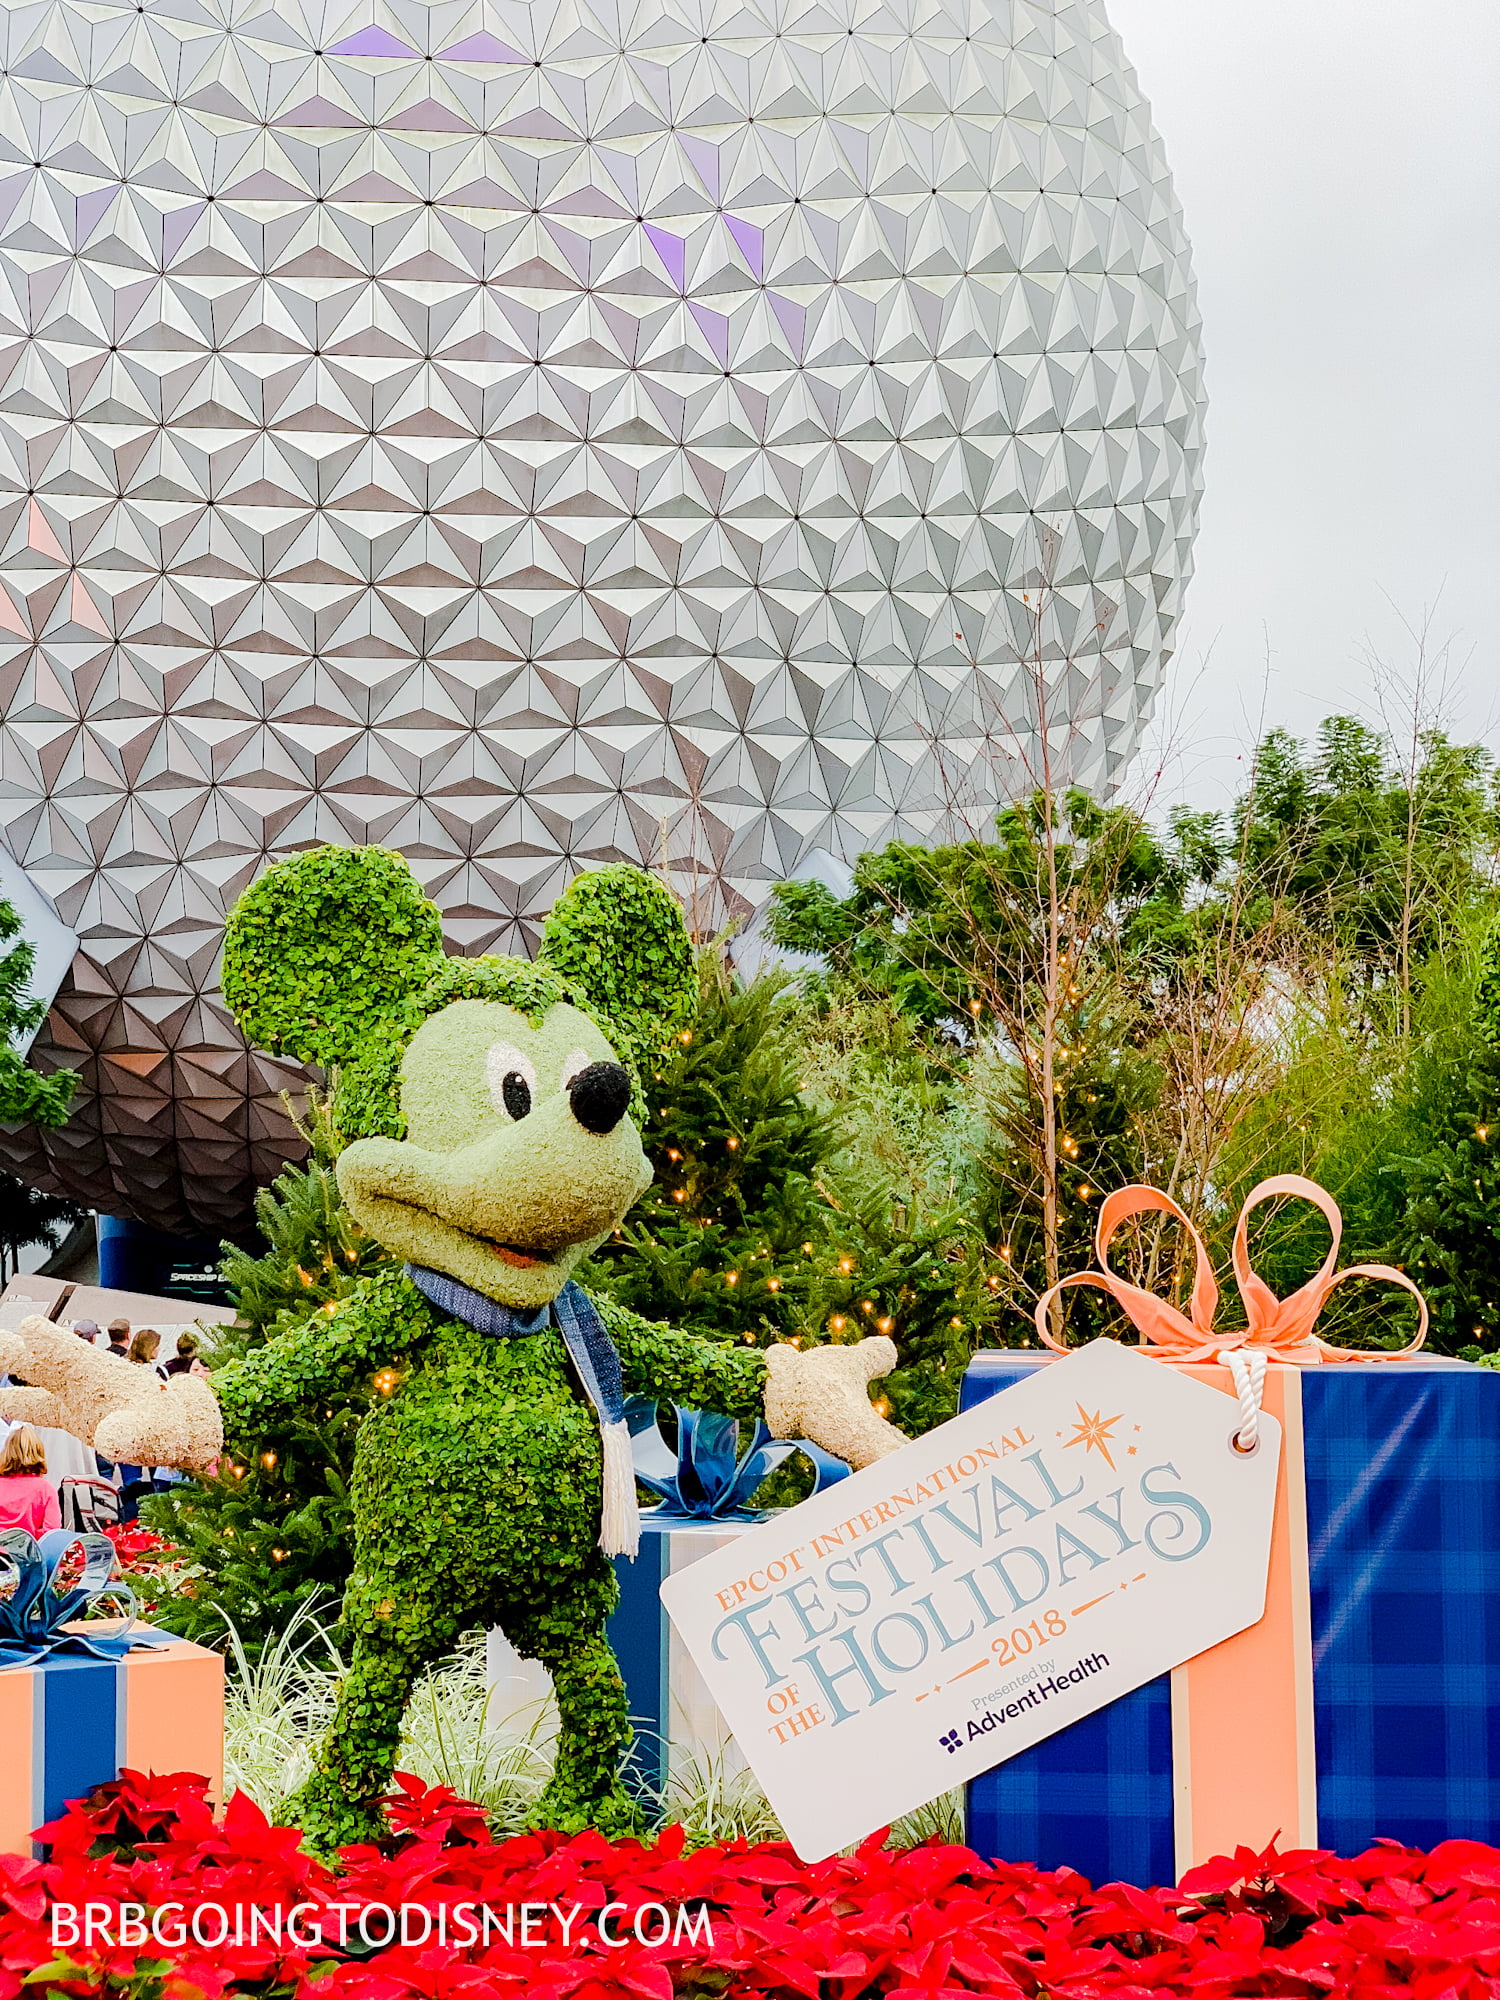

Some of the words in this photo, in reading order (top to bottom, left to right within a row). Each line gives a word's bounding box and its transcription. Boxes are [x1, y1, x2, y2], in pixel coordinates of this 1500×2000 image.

[809, 1426, 1035, 1559] INTERNATIONAL
[711, 1449, 1084, 1689] FESTIVAL
[792, 1462, 1212, 1727] HOLIDAYS
[991, 1609, 1067, 1667] 2018
[767, 1682, 801, 1715] OF
[966, 1653, 1110, 1741] AdventHealth
[971, 1667, 1039, 1711] Presented
[1038, 1659, 1056, 1674] by
[768, 1703, 826, 1745] THE
